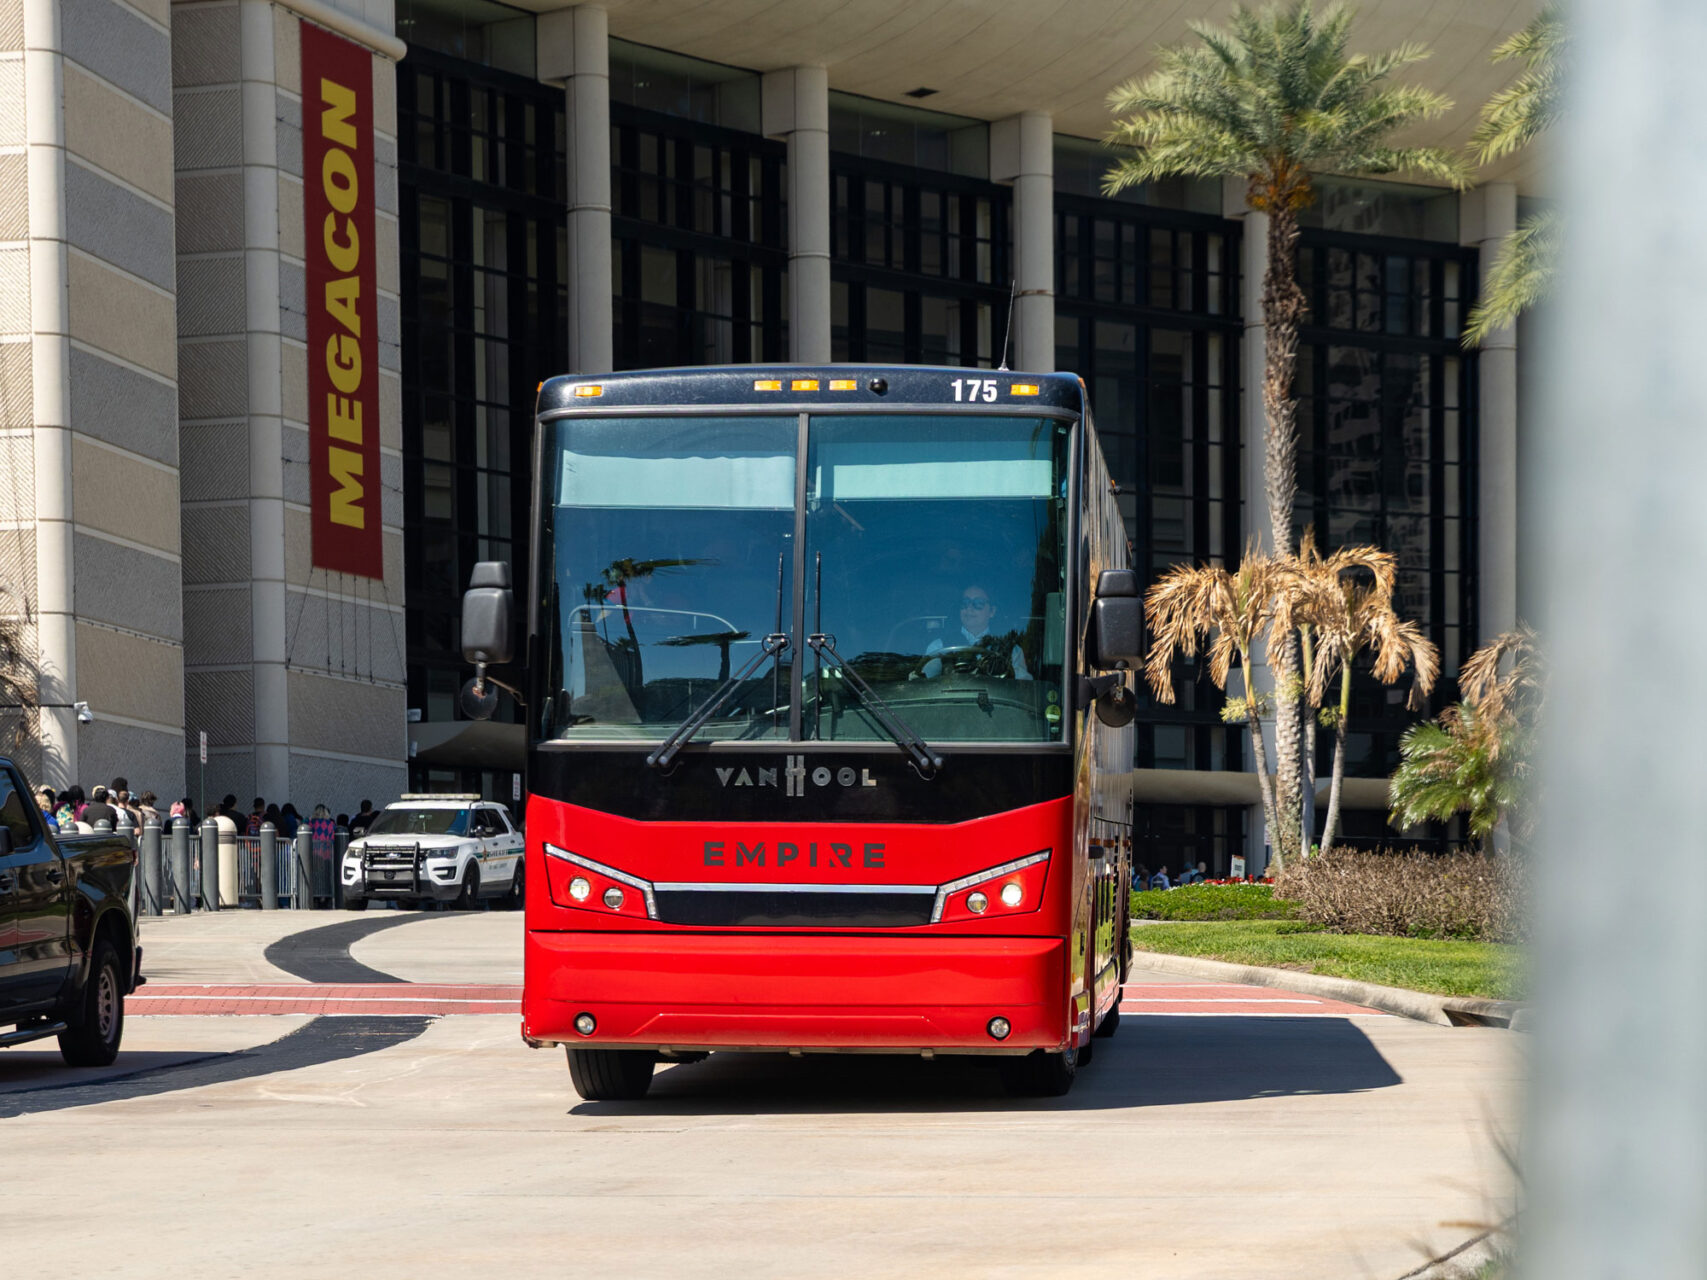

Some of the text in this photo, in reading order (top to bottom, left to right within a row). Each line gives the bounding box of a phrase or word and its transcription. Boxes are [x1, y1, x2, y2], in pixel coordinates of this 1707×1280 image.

[321, 77, 364, 529] MEGACON
[951, 379, 998, 402] 175
[703, 841, 886, 868] EMPIRE
